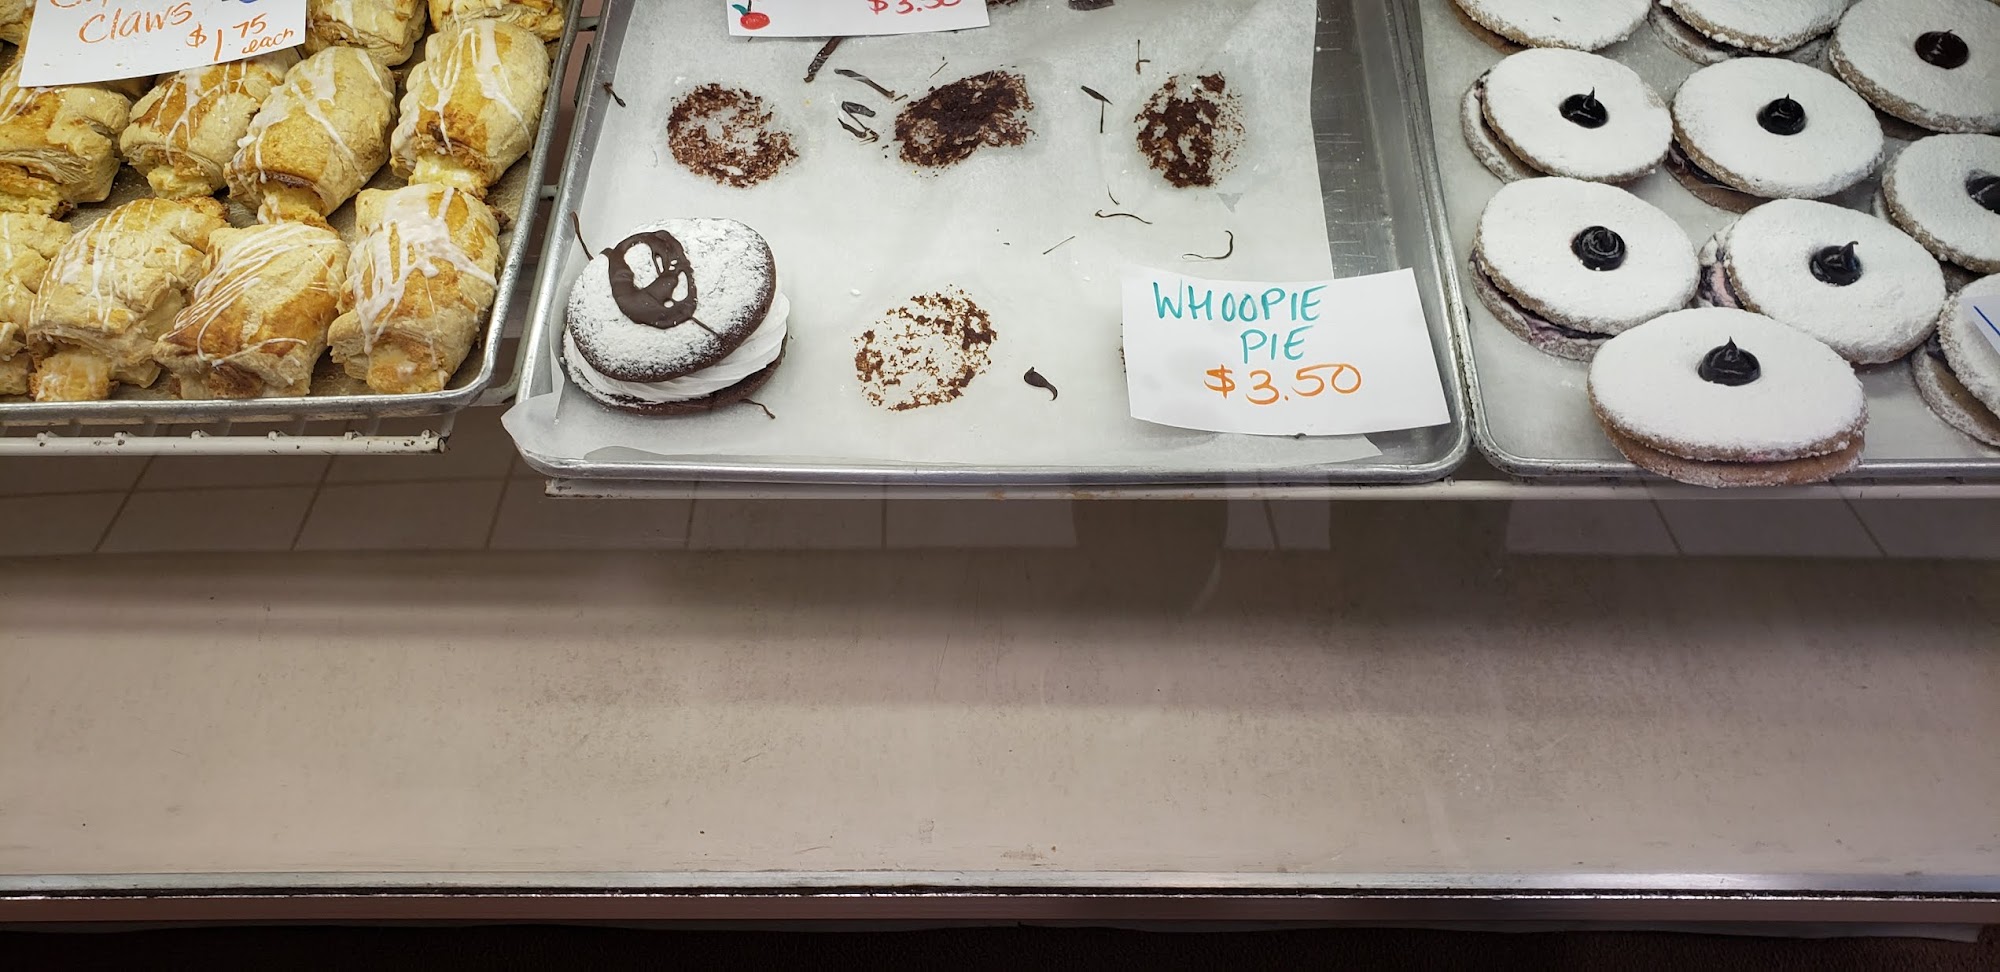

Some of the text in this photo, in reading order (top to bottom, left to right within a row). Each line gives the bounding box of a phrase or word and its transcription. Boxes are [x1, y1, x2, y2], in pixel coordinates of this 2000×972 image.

[79, 2, 193, 43] Claws
[242, 28, 294, 54] each
[1153, 279, 1328, 322] WHOOPIE
[1240, 325, 1314, 364] PIE
[1204, 363, 1362, 405] $3.50
